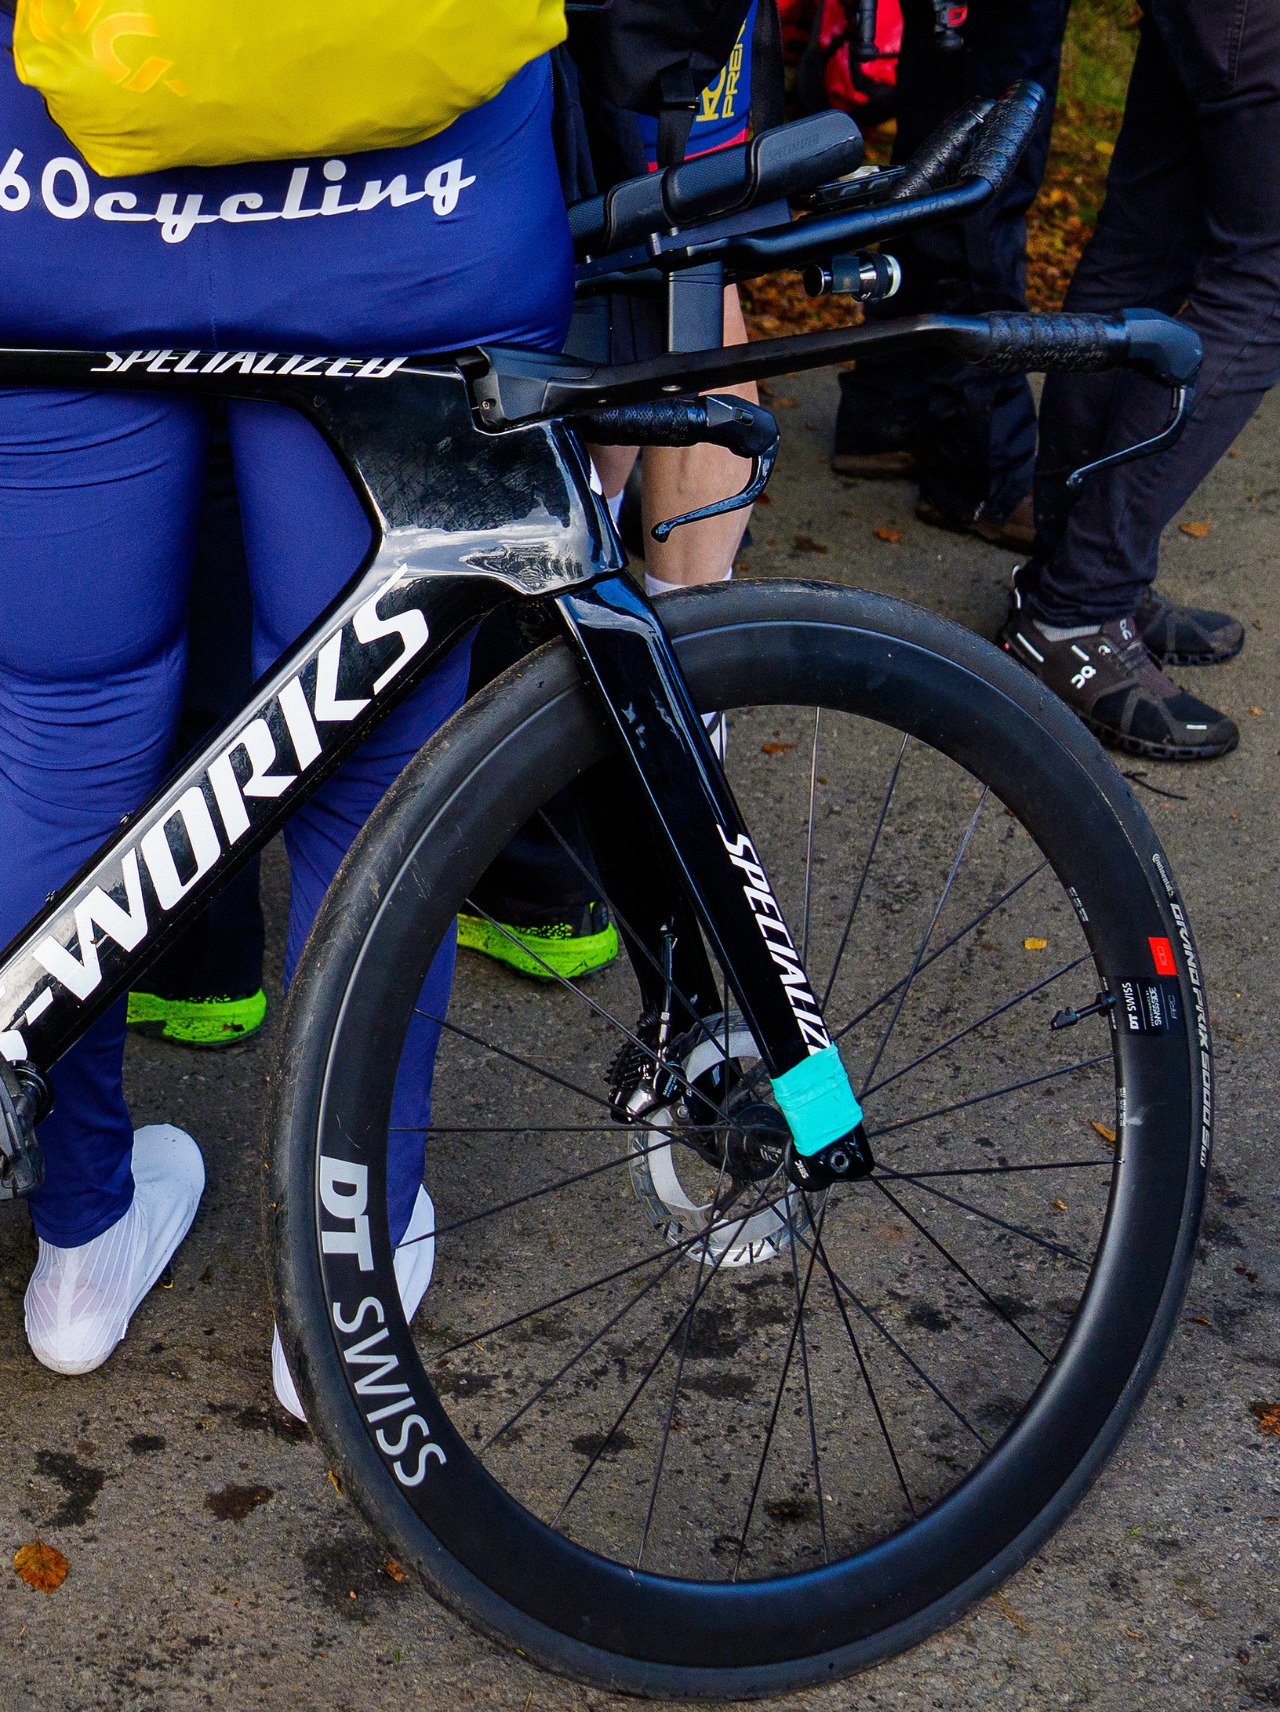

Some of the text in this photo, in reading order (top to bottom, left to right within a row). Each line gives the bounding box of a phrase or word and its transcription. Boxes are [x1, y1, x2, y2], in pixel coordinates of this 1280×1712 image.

[716, 824, 831, 1056] SPECIALIZ
[1122, 982, 1139, 1030] DT SWISS
[1171, 903, 1201, 988] GRAND
[1193, 986, 1209, 1048] PRIX
[1201, 1050, 1211, 1127] 5000
[320, 1155, 447, 1487] DT SWISS
